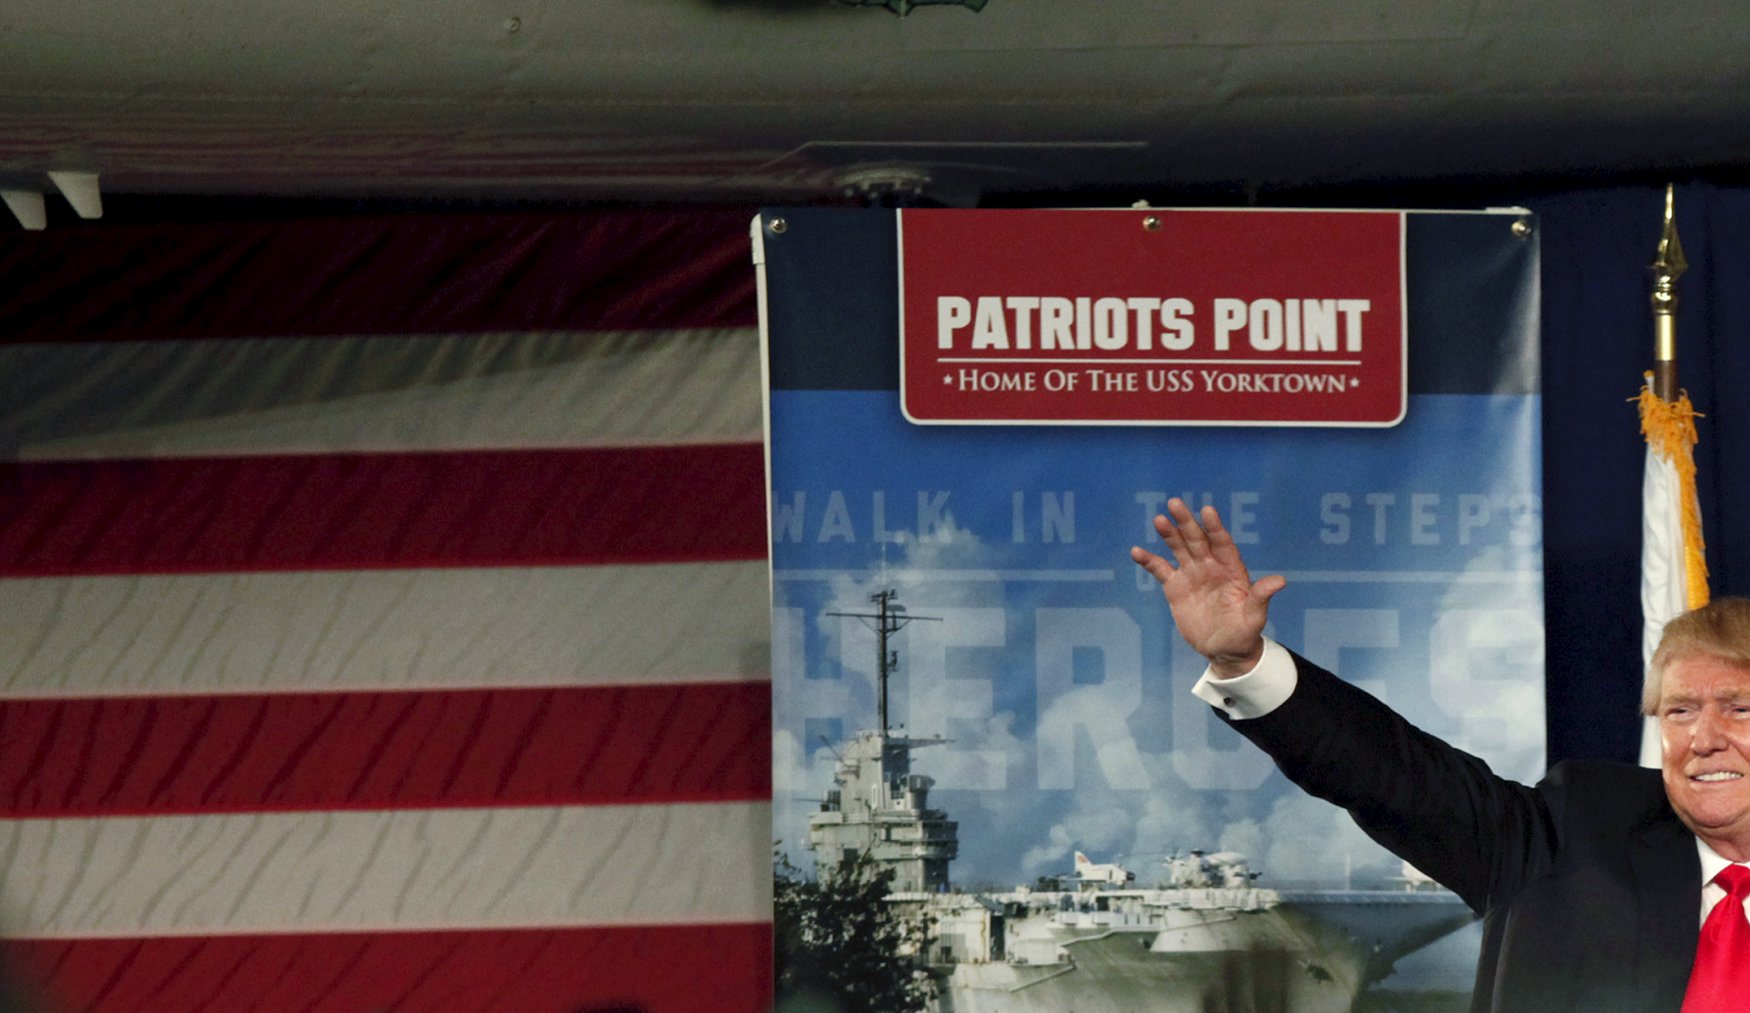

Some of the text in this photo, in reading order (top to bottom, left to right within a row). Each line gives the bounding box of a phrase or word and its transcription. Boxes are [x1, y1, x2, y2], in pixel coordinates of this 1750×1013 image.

[938, 296, 1371, 352] PATRIOTS POINT
[1146, 371, 1195, 393] USS
[1202, 371, 1347, 393] YORKTOWN
[772, 490, 951, 543] WALK
[1012, 491, 1075, 543] IN
[1135, 492, 1260, 544] TE
